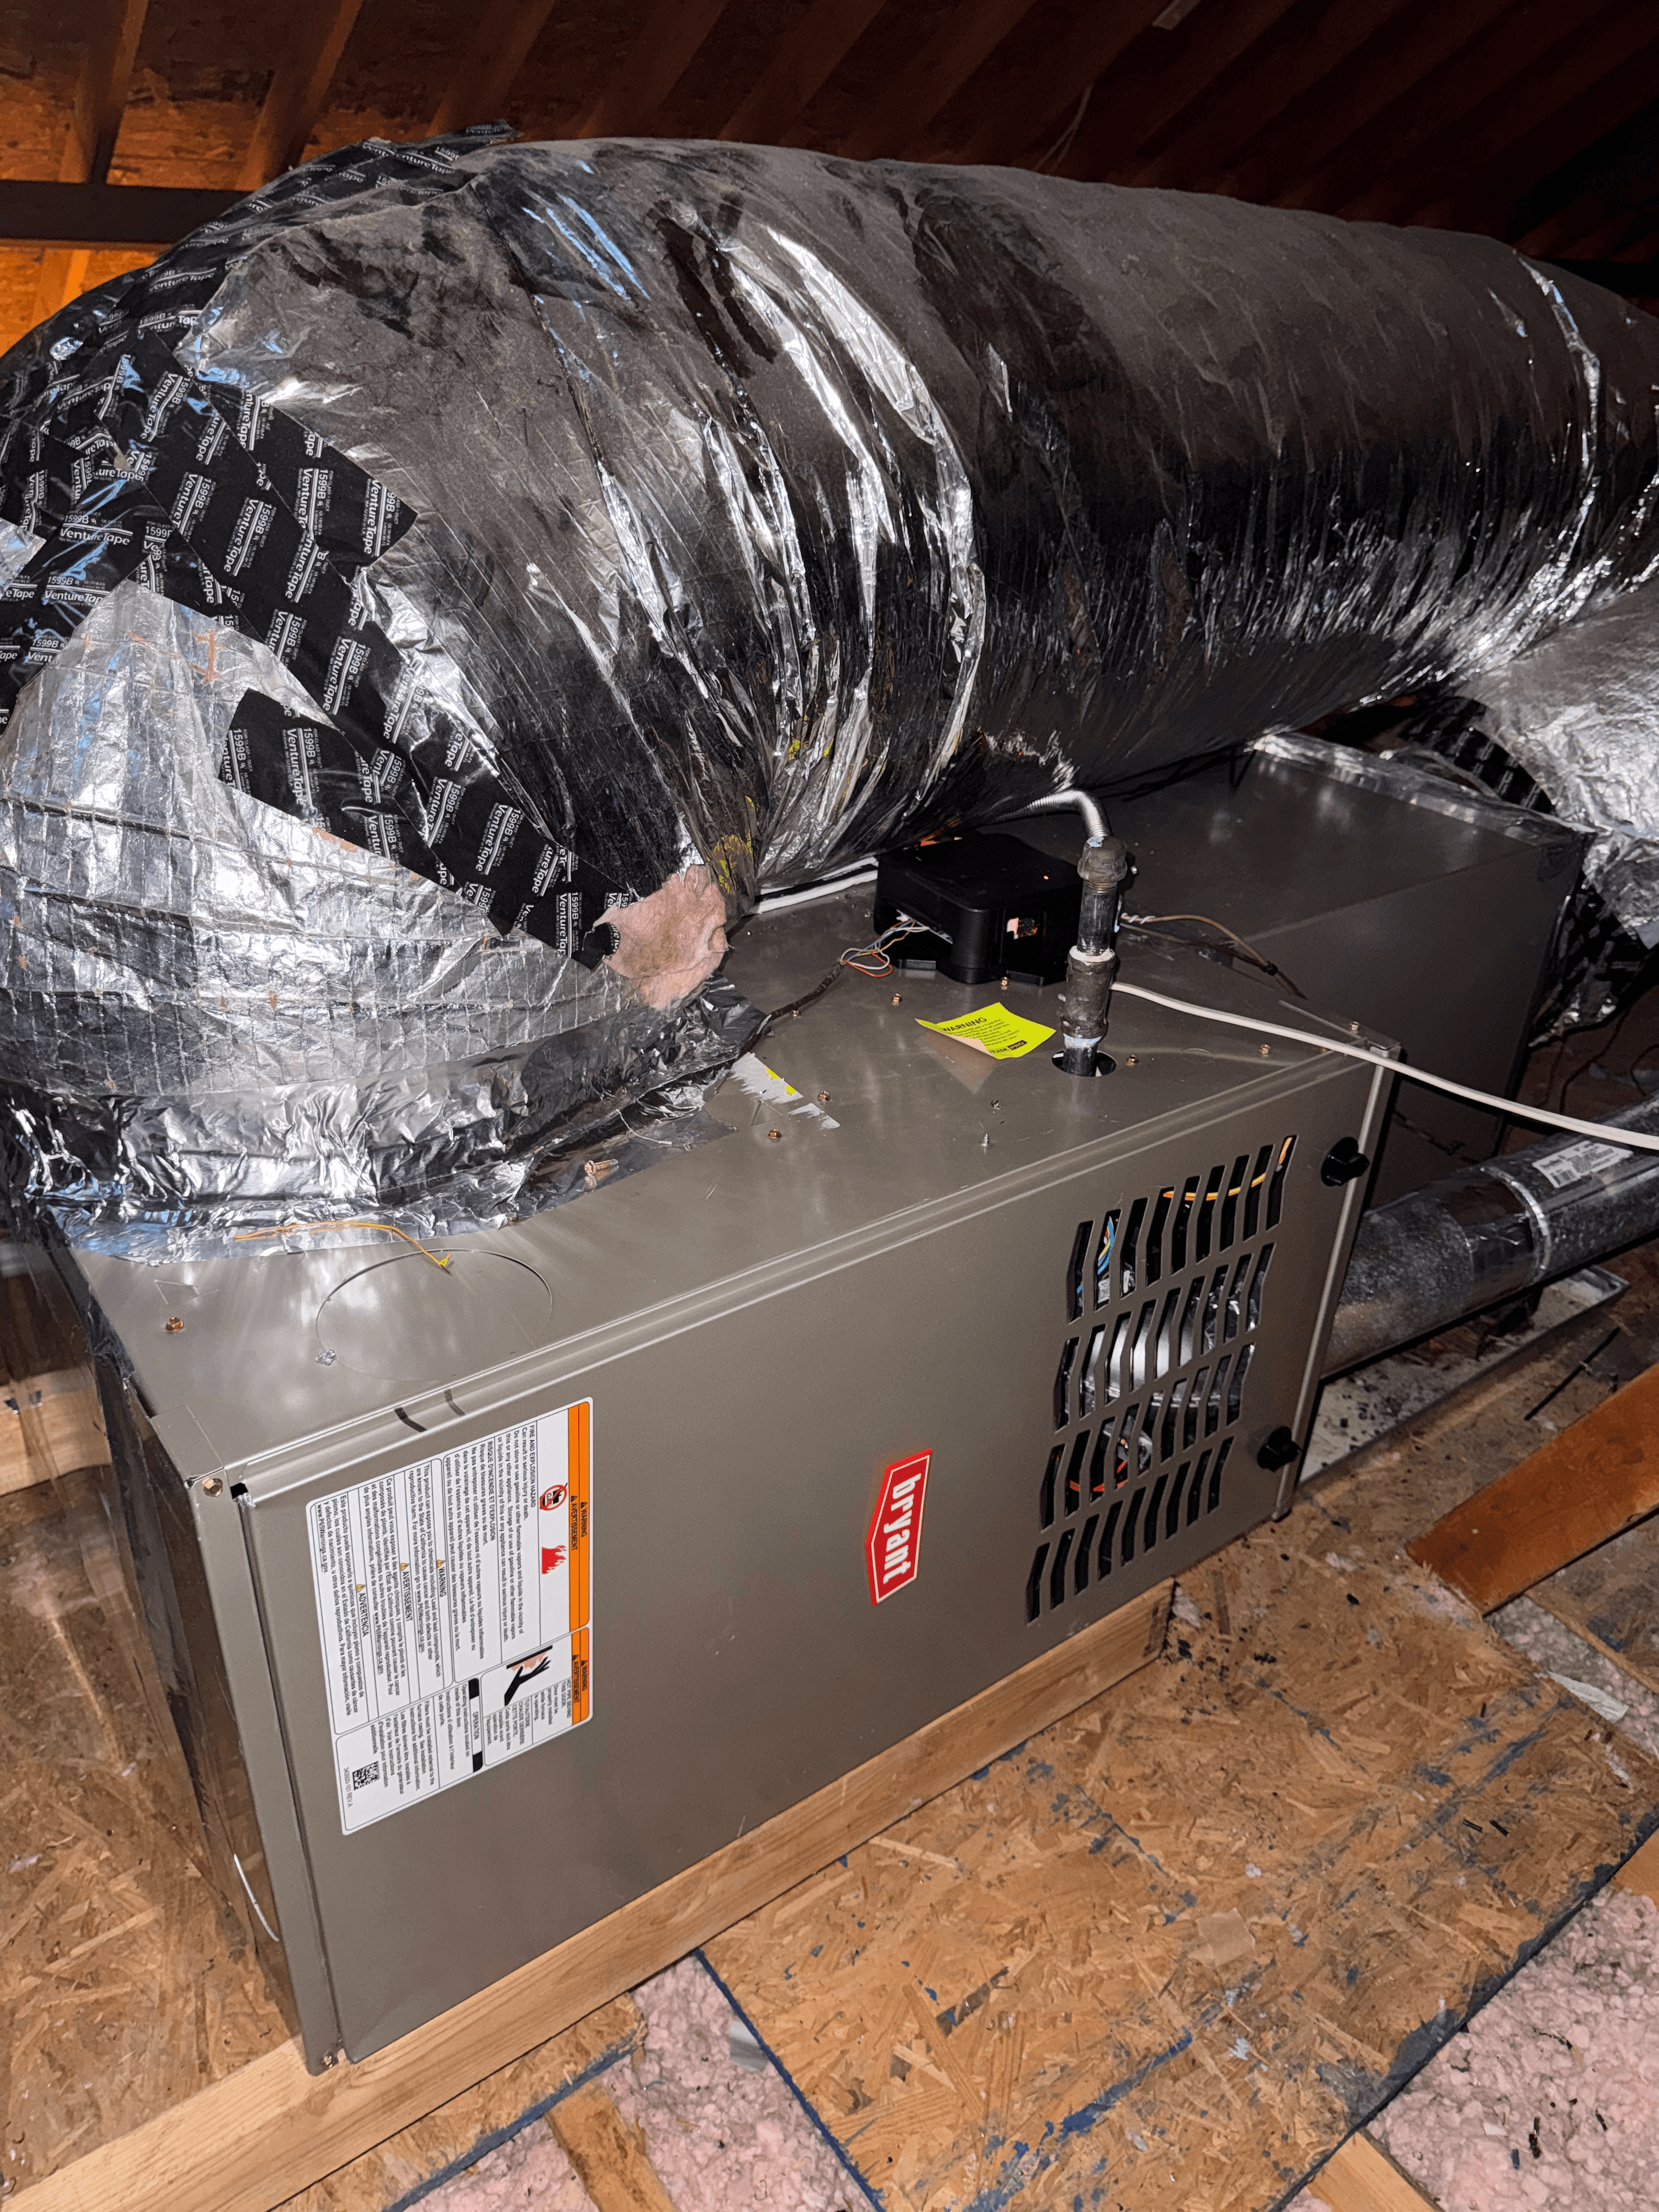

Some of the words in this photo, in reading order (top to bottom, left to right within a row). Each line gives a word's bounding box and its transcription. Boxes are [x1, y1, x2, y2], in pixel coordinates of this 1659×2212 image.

[140, 373, 178, 439] VentureTape
[172, 377, 190, 404] 1599B
[195, 478, 212, 509] 1599B
[317, 469, 328, 499] 1599B
[65, 515, 89, 524] 1599B
[255, 504, 272, 534] 1599B
[363, 479, 381, 554] VentureTape
[60, 528, 130, 545] VentureTape
[224, 499, 259, 572] VentureTape
[48, 576, 74, 585] 1599B
[32, 639, 59, 648] 1599B
[286, 616, 302, 647] 1599B
[349, 643, 366, 674] 1599B
[323, 638, 352, 711] VentureTape
[233, 729, 246, 760] 1599B
[304, 727, 316, 760] 1599B
[287, 729, 304, 805] VentureTape
[387, 755, 402, 784] 1599B
[445, 783, 461, 812] 1599B
[385, 814, 397, 843] 1599B
[476, 804, 509, 871] VentureTape
[504, 809, 521, 836] 1599B
[422, 1477, 431, 1499] product
[883, 1473, 921, 1584] bryant
[408, 1470, 416, 1504] reproductive
[416, 1589, 425, 1654] www.P65Warnings.ca.gov.
[402, 1571, 413, 1621] AVERTISSEMENT
[438, 1566, 447, 1597] WARNING
[358, 1593, 369, 1637] ADVERTENCIA
